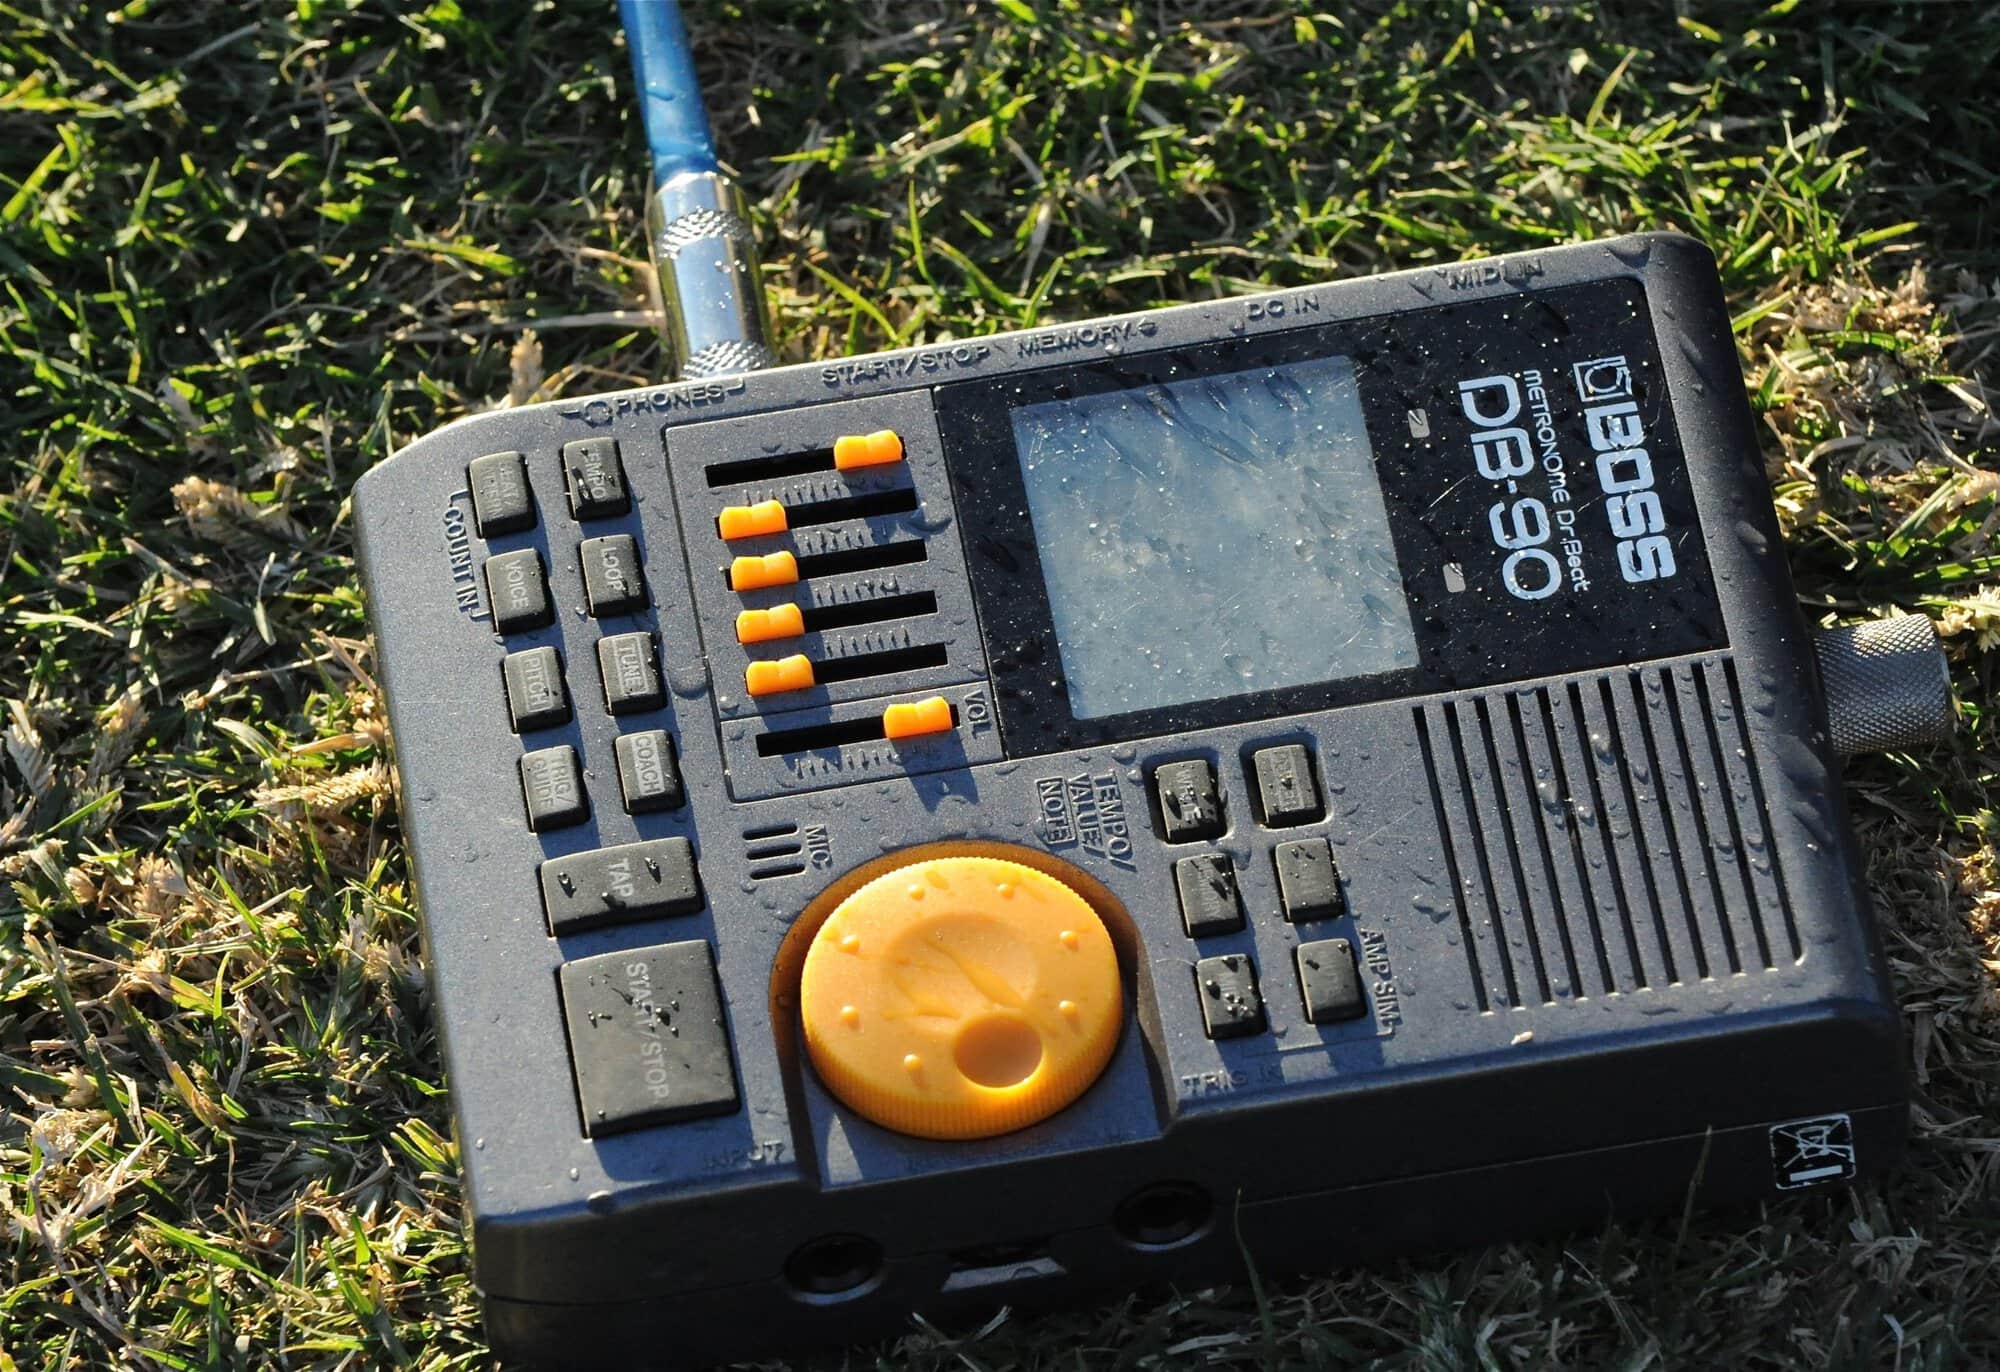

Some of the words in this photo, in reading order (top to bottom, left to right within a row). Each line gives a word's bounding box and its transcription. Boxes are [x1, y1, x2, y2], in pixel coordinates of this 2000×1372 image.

[1247, 299, 1286, 321] DC
[1294, 293, 1321, 315] IN
[1017, 319, 1132, 359] MEMORY
[821, 344, 992, 386] START/STOP
[615, 382, 726, 416] PHONES
[481, 462, 503, 519] ATTERN
[1458, 374, 1562, 600] DB-90
[1584, 401, 1677, 583] BOSS
[443, 506, 476, 582] COUNT
[601, 546, 625, 592] LOOP
[456, 585, 481, 612] IN
[504, 559, 530, 610] VOICE
[524, 656, 550, 710] PITCH
[618, 643, 642, 687] TUNE
[963, 689, 990, 740] VOL
[532, 757, 555, 808] GUIDE
[550, 752, 578, 806] TRIG/
[634, 735, 662, 794] COACH
[1040, 780, 1074, 842] NOTE
[1068, 772, 1106, 859] VALUE/
[1093, 770, 1138, 872] TEMPO/
[804, 823, 832, 870] MIC
[606, 857, 634, 899] TAP
[1360, 927, 1395, 981] AMP
[626, 961, 671, 1099] START/STOP
[1374, 981, 1403, 1028] SIM
[1182, 1070, 1248, 1097] TRIG
